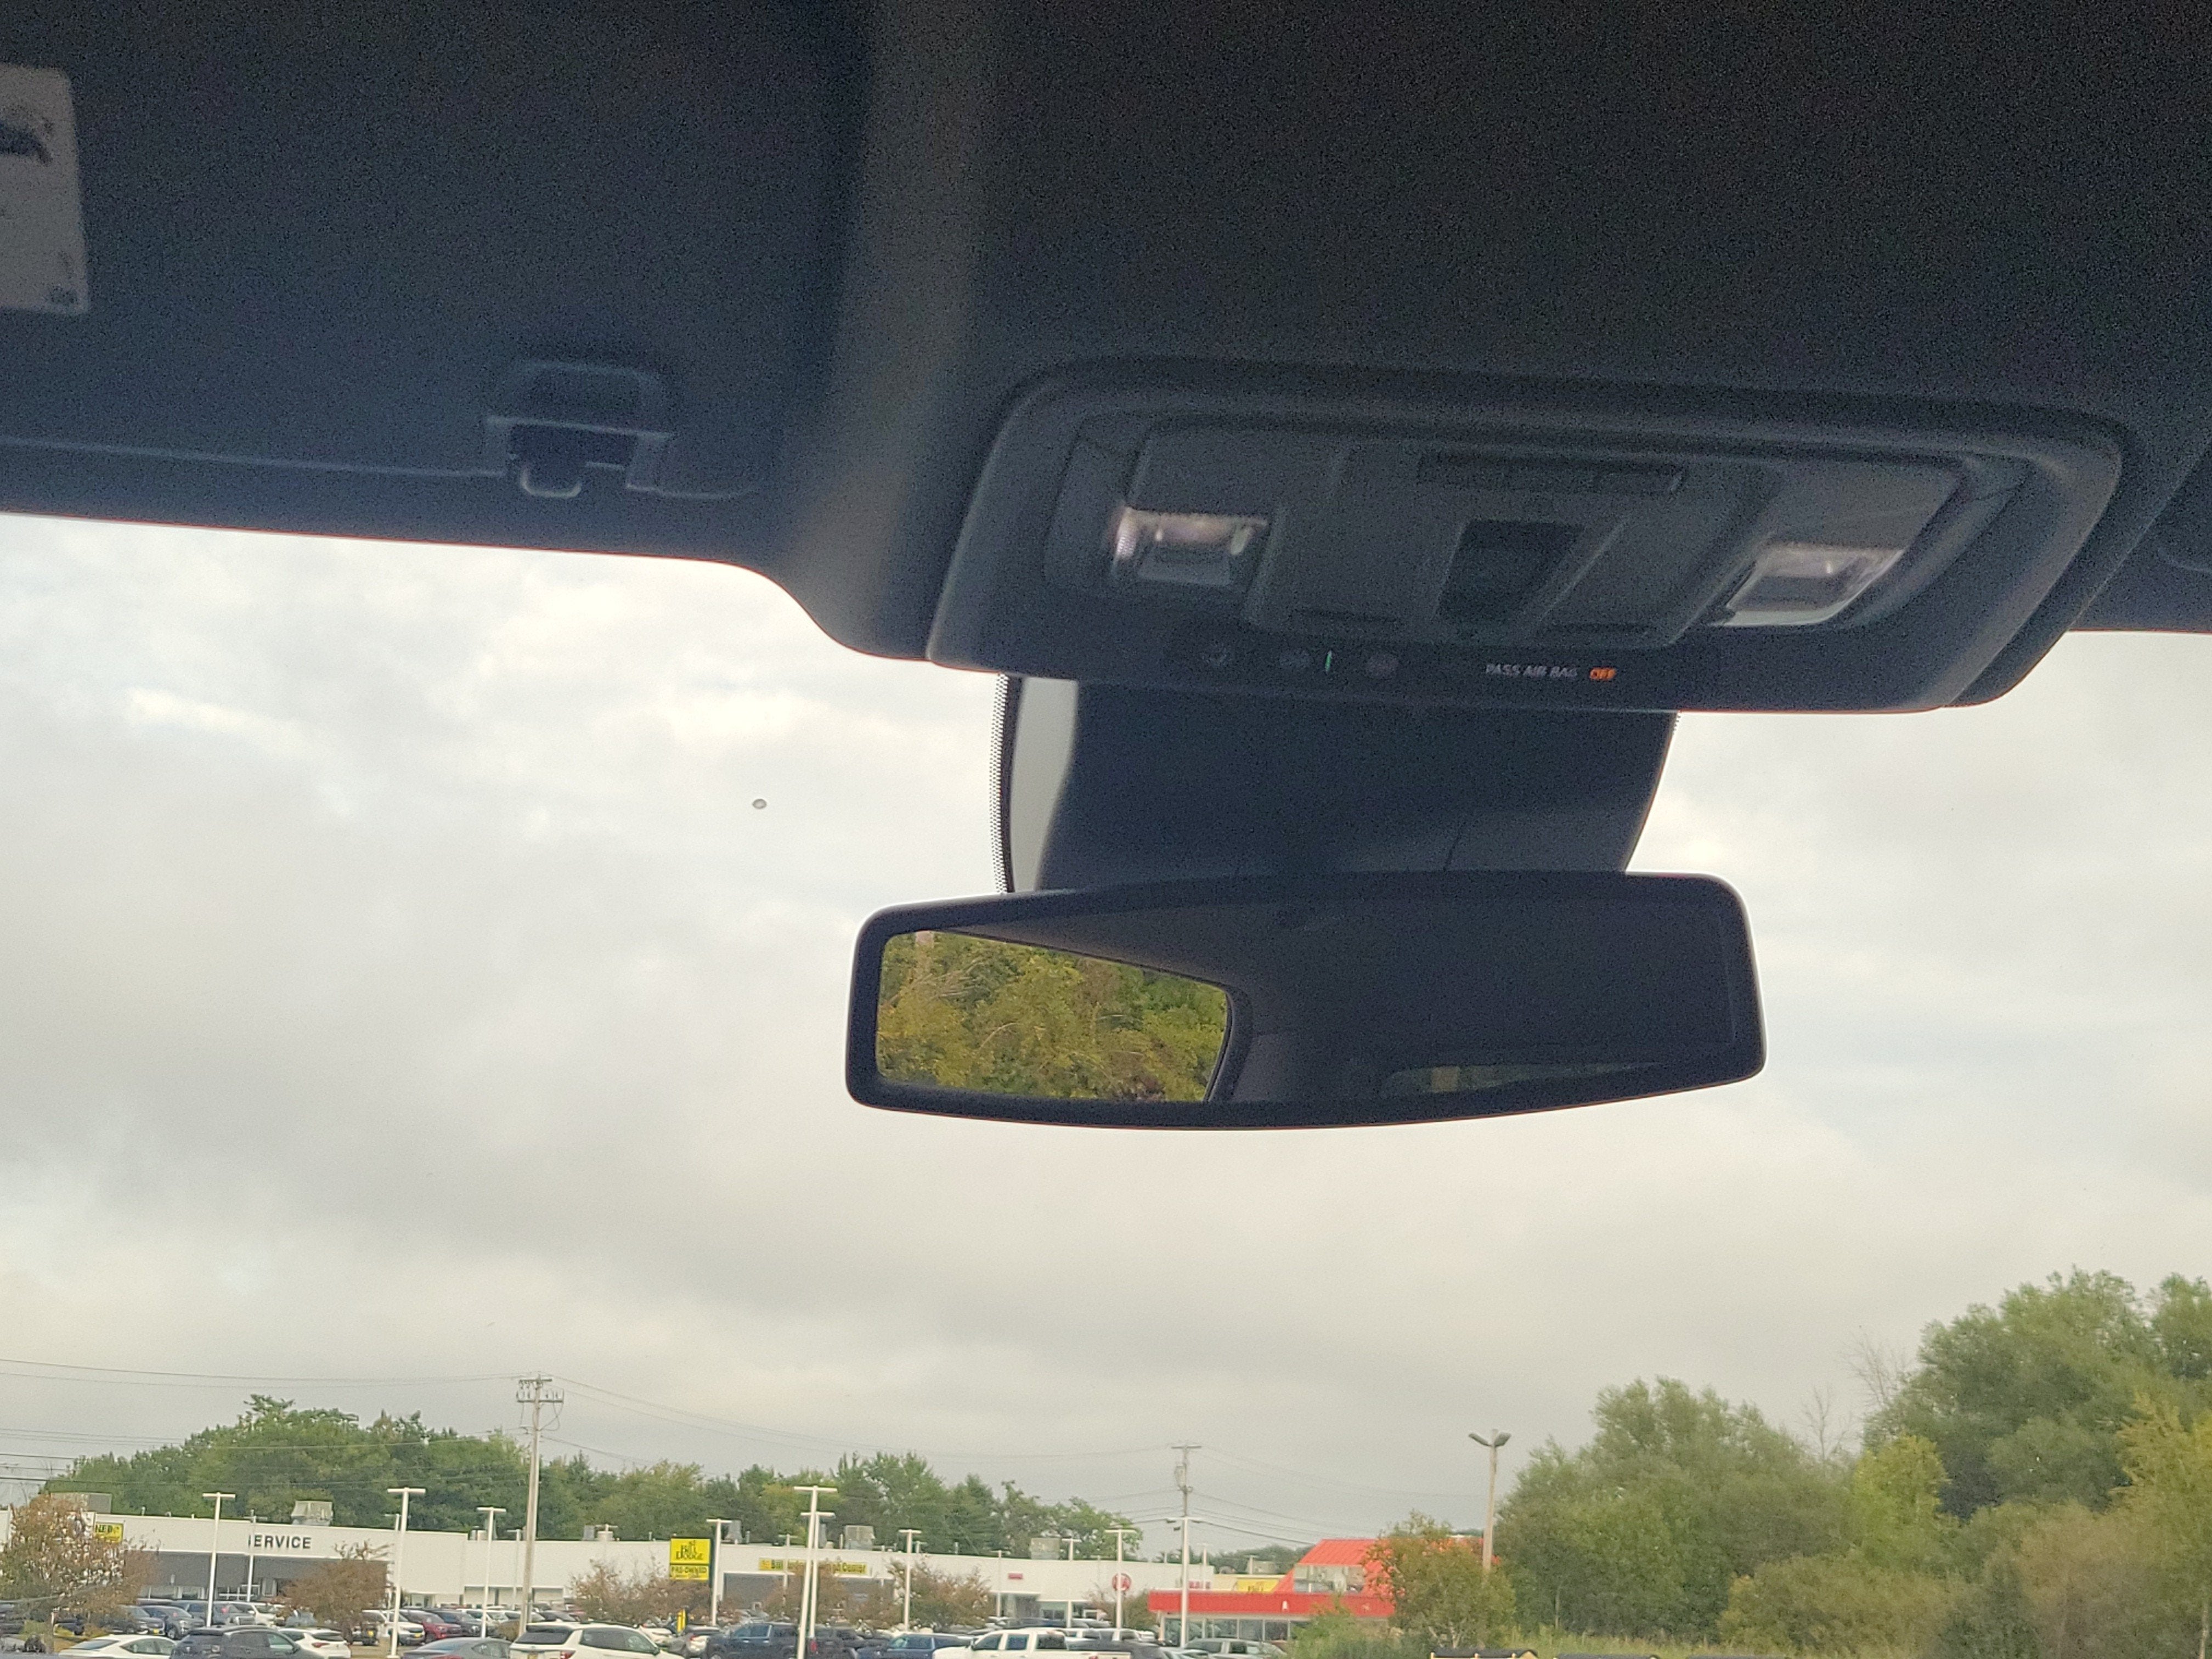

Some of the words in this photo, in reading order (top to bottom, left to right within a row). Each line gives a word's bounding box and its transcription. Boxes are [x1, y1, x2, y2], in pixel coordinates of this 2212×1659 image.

[1486, 664, 1521, 676] PASS
[1523, 665, 1547, 677] AIR
[1549, 665, 1578, 678] BAG
[1589, 667, 1616, 680] OFF
